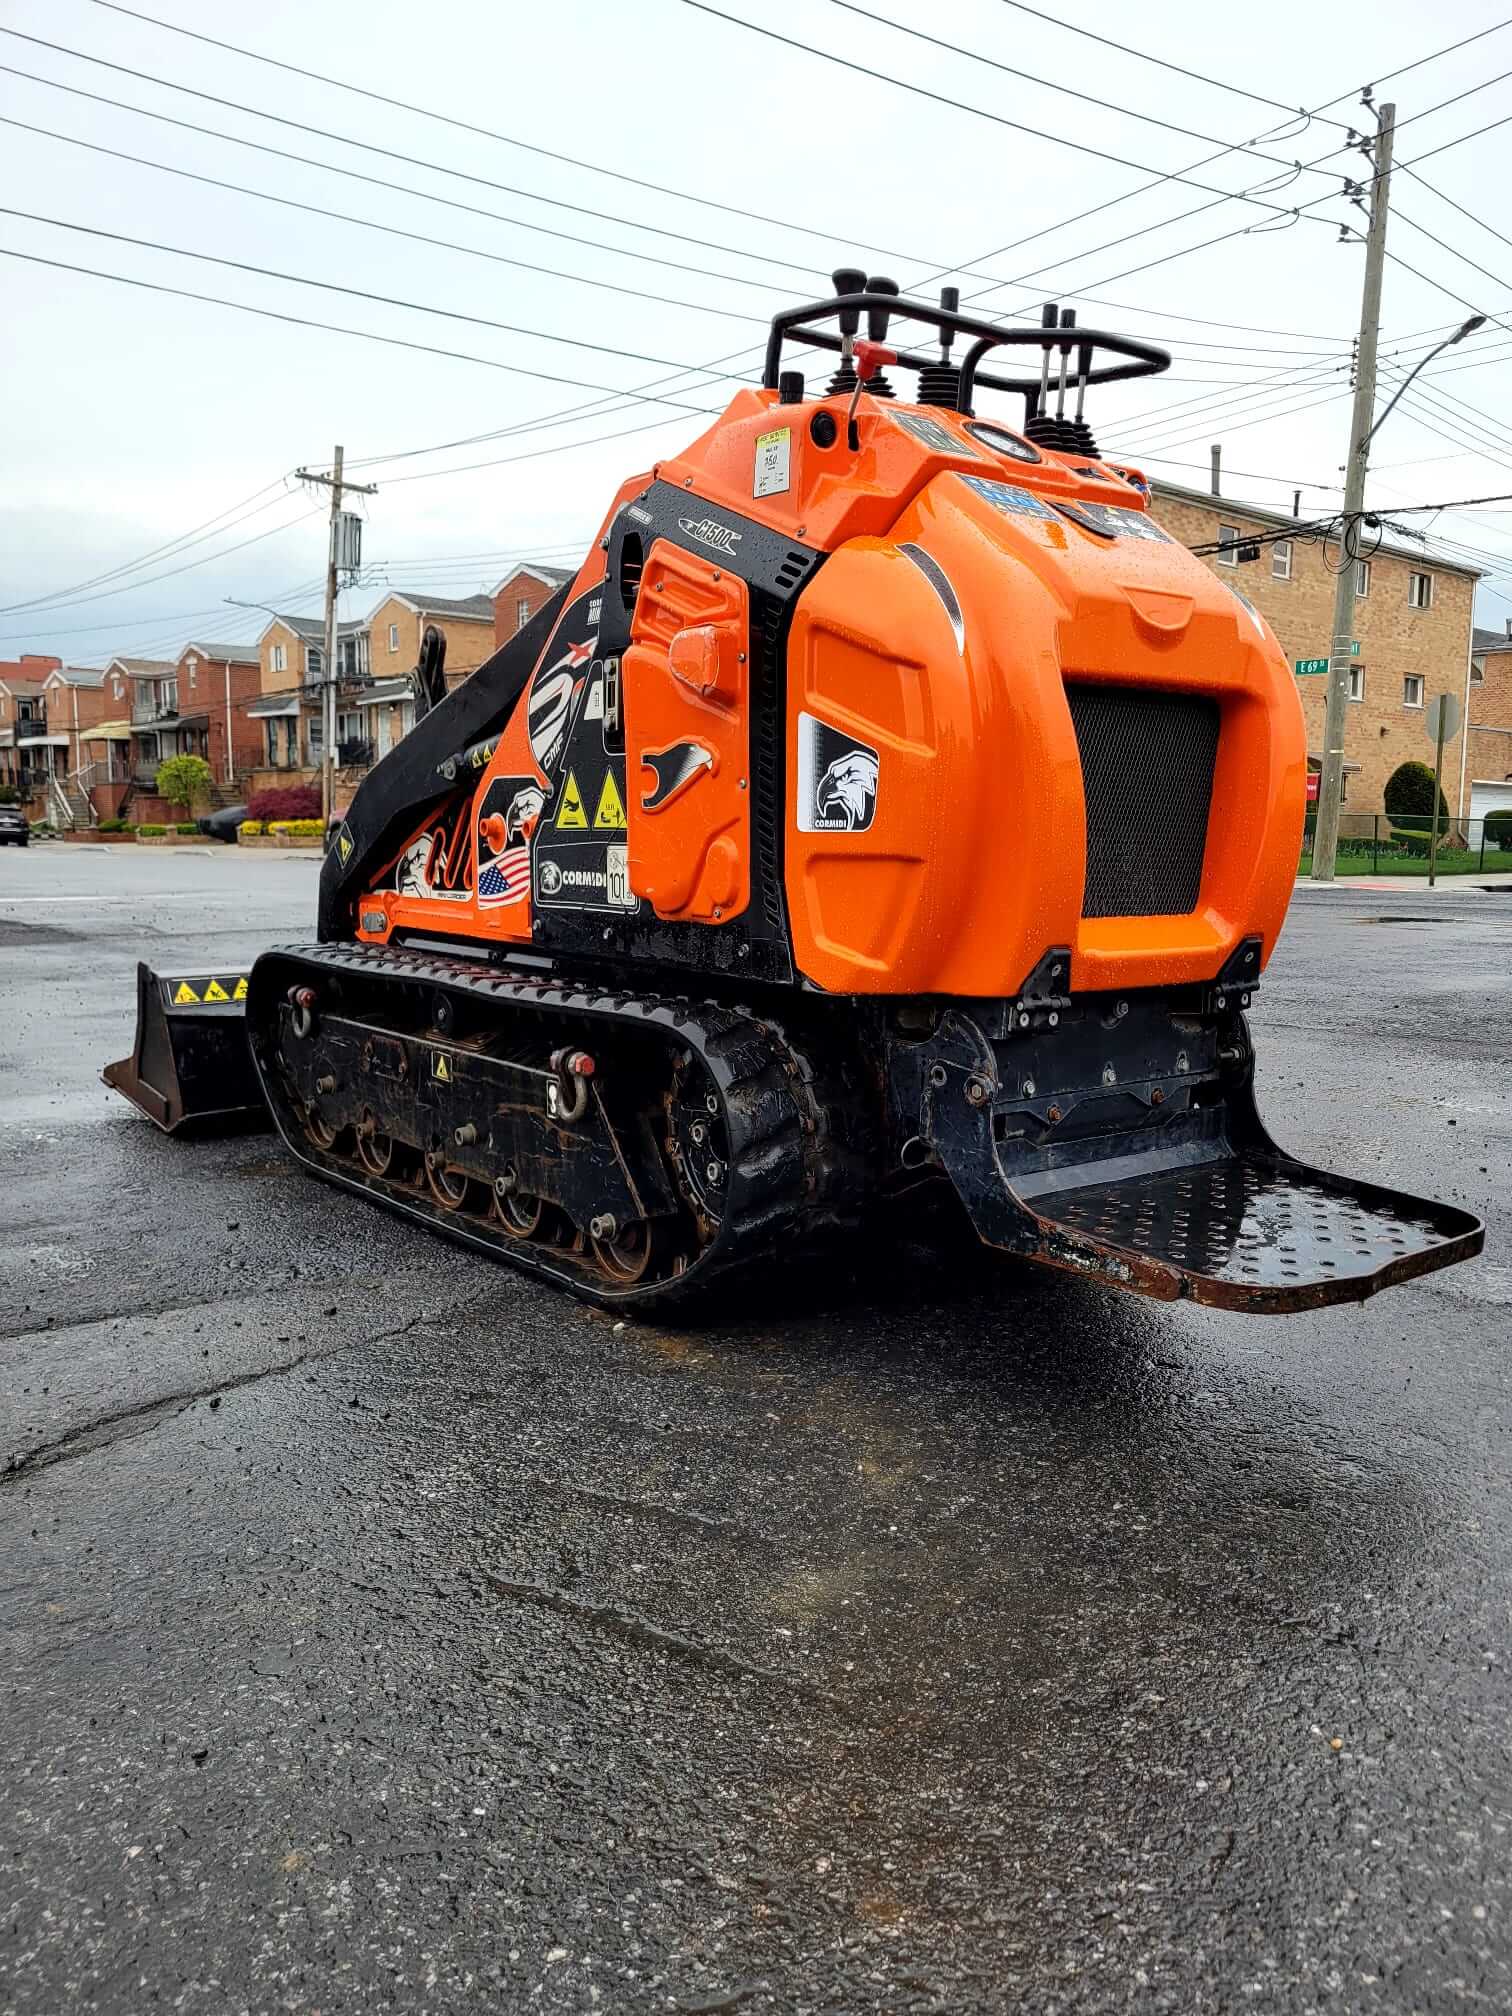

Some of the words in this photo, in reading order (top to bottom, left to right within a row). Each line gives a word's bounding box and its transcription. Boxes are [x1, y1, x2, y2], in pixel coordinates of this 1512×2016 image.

[1301, 662, 1306, 672] E
[1307, 661, 1318, 672] 69
[544, 732, 563, 770] CMF
[814, 819, 847, 828] CORMIDI
[562, 870, 607, 888] CORMIDI
[609, 873, 626, 899] 101
